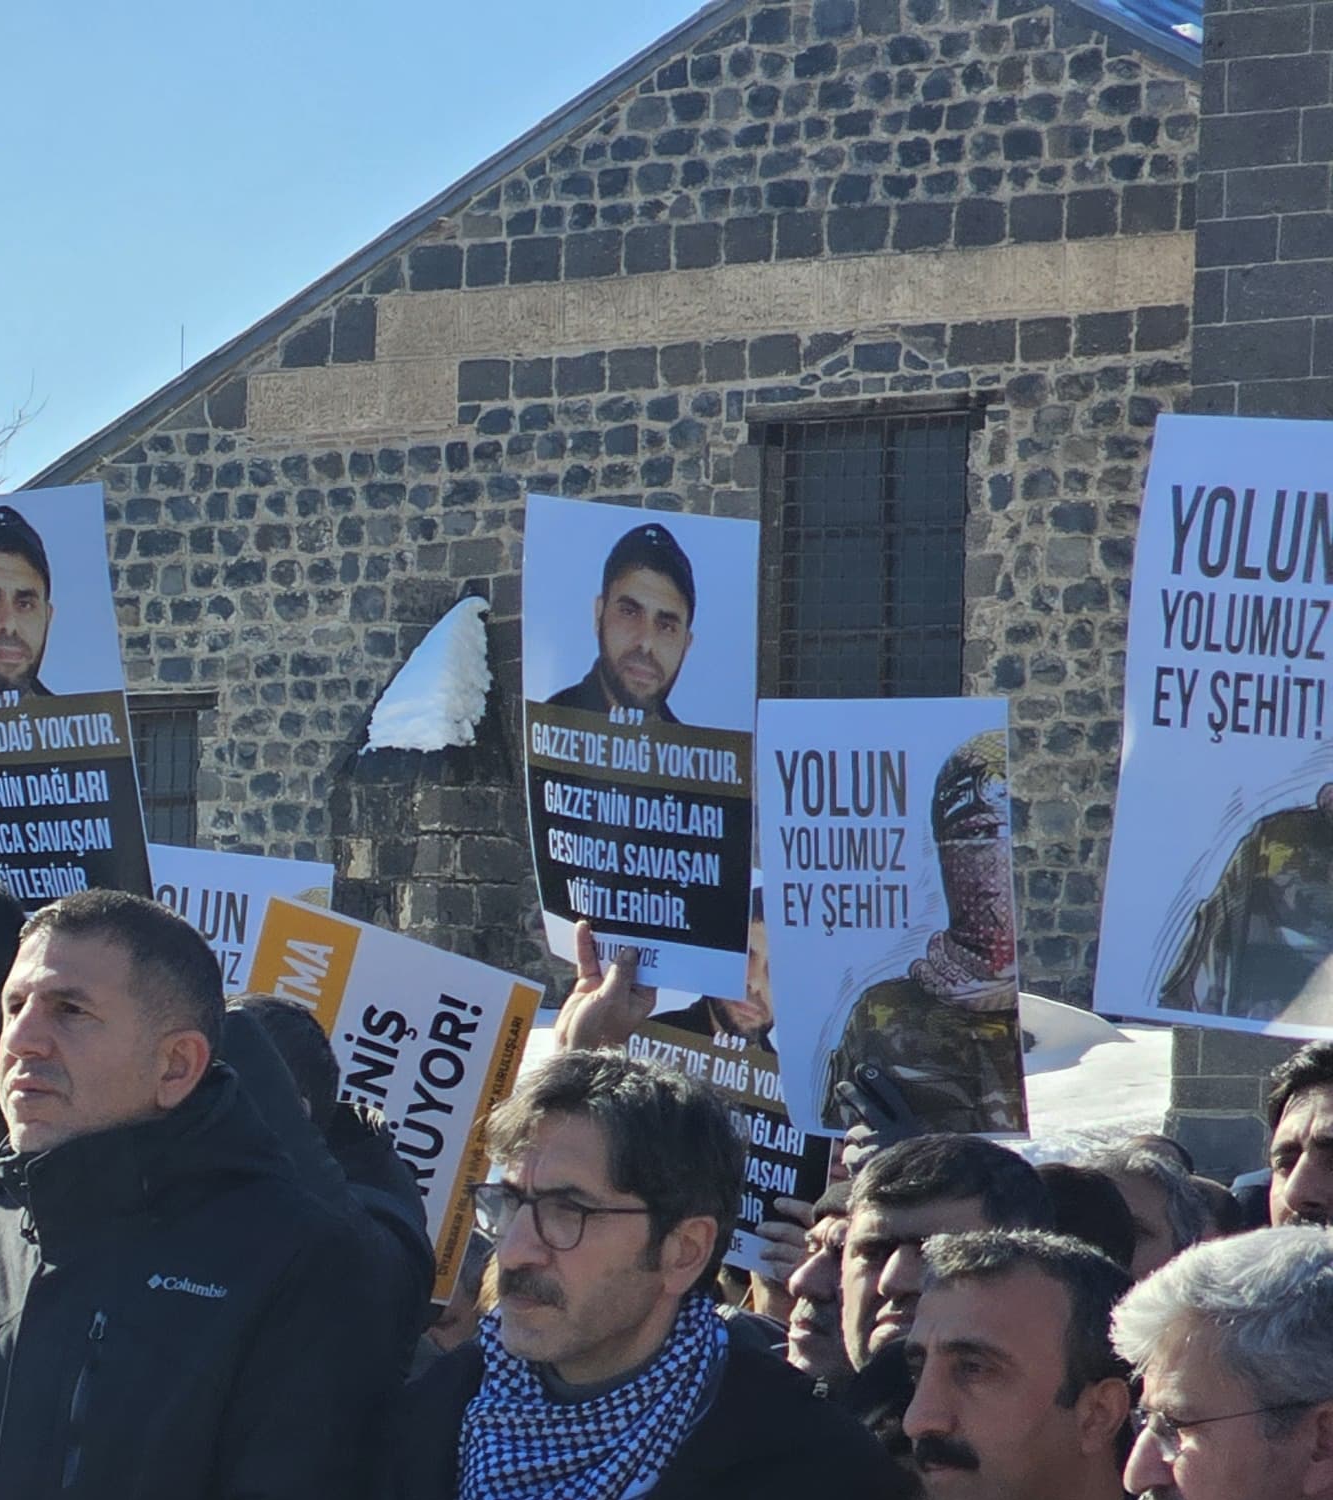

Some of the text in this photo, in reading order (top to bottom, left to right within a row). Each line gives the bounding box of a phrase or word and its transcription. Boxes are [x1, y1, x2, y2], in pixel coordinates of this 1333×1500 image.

[1171, 484, 1333, 585] YOLUN
[1161, 588, 1331, 660] YOLUMUZ
[35, 712, 120, 750] YOKTUR.
[1152, 664, 1326, 743] EY ŞEHİT!
[532, 721, 743, 785] GAZZE'DE DAĞ YOKTUR.
[26, 767, 110, 806] DAĞLARI
[544, 779, 724, 839] GAZZE'NİN DAĞLARI
[775, 750, 907, 817] YOLUN
[25, 817, 113, 857] SAVAŞAN
[548, 828, 721, 888] CESURCA SAVAŞAN
[779, 826, 906, 871] YOLUMUZ
[566, 875, 691, 930] YİĞİTLERİDİR.
[783, 876, 909, 936] EY ŞEHİT!
[712, 1057, 750, 1092] DAĞ
